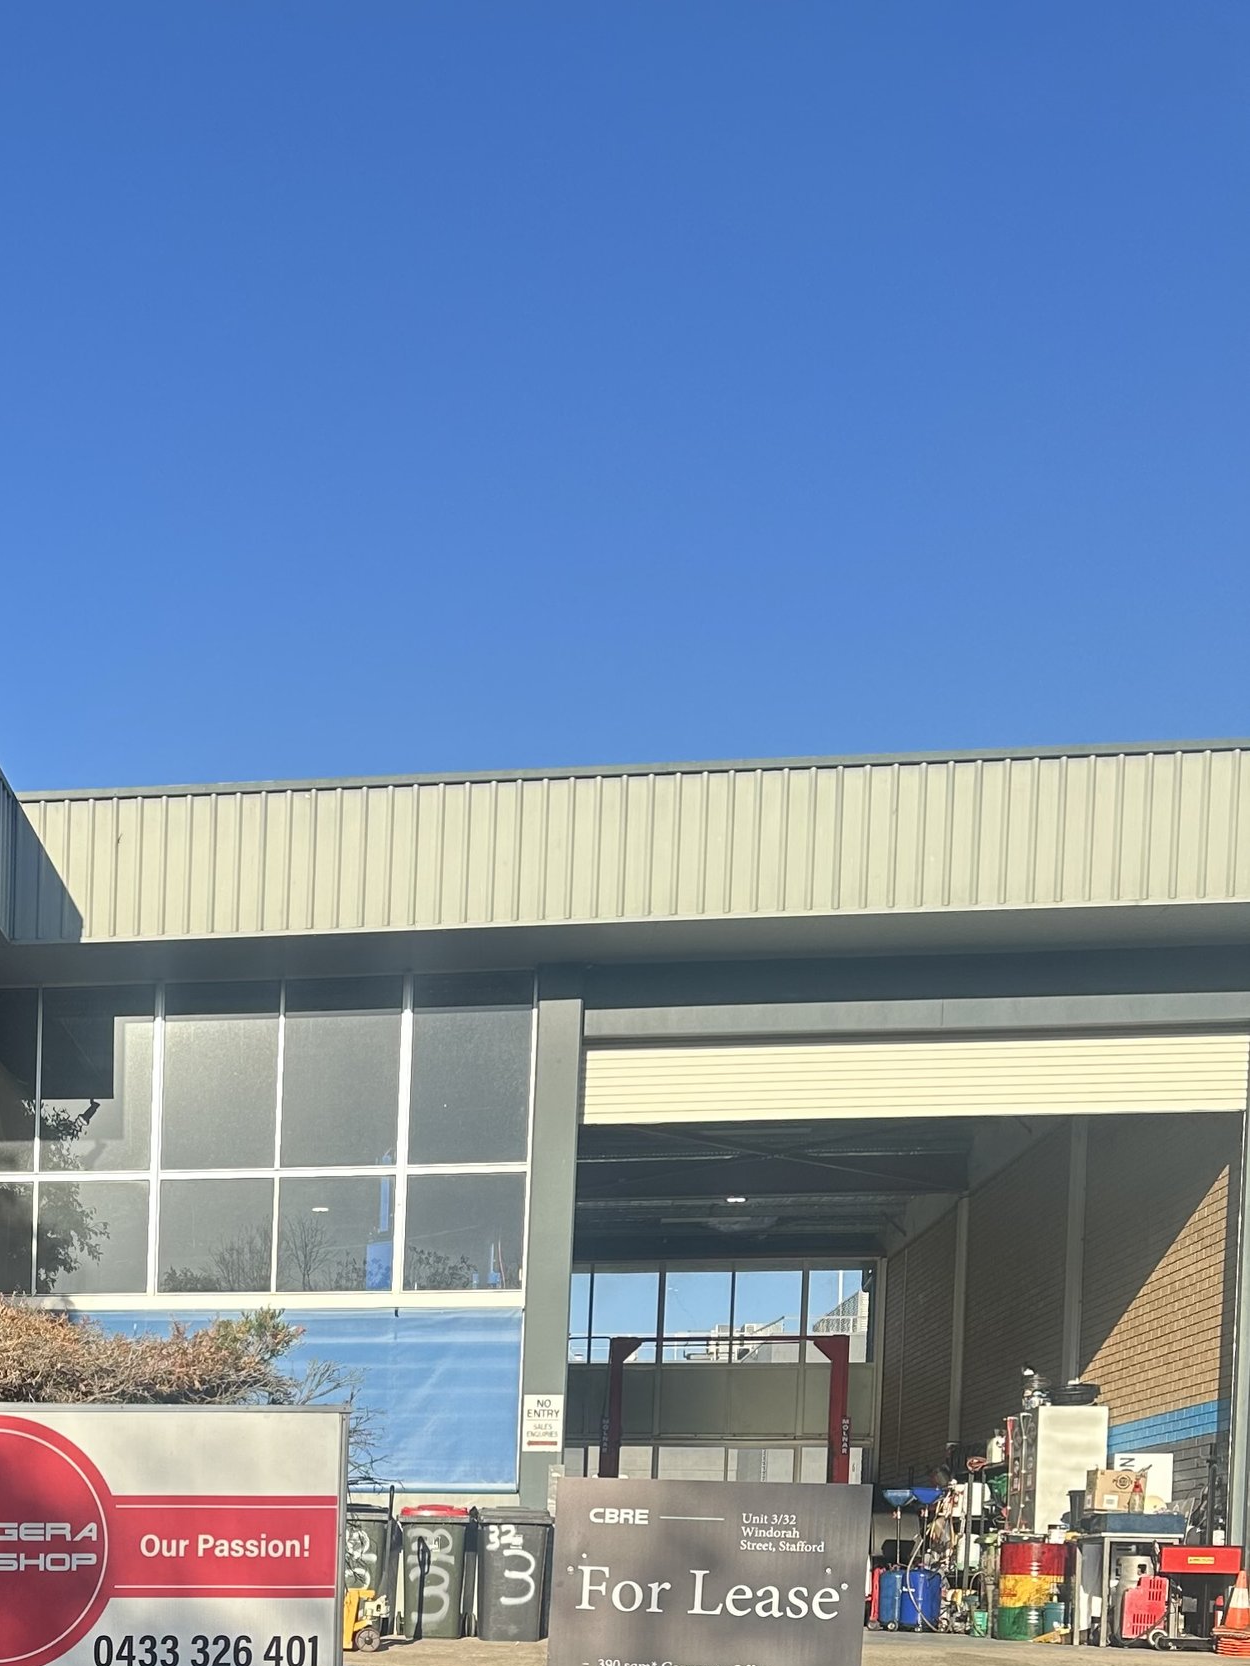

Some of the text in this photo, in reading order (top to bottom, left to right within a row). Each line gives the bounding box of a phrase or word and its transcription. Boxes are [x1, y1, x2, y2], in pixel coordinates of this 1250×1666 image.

[537, 1399, 551, 1408] NO
[527, 1408, 560, 1418] ENTRY
[841, 1418, 850, 1454] MOLNAR
[589, 1507, 649, 1525] CBRE
[742, 1513, 796, 1525] Unit 3/32
[486, 1524, 517, 1551] 32
[741, 1526, 800, 1538] Windorah
[140, 1533, 311, 1558] Our Passion!
[740, 1539, 825, 1552] Street, Stafford
[499, 1549, 536, 1606] 3
[575, 1565, 840, 1621] For Lease
